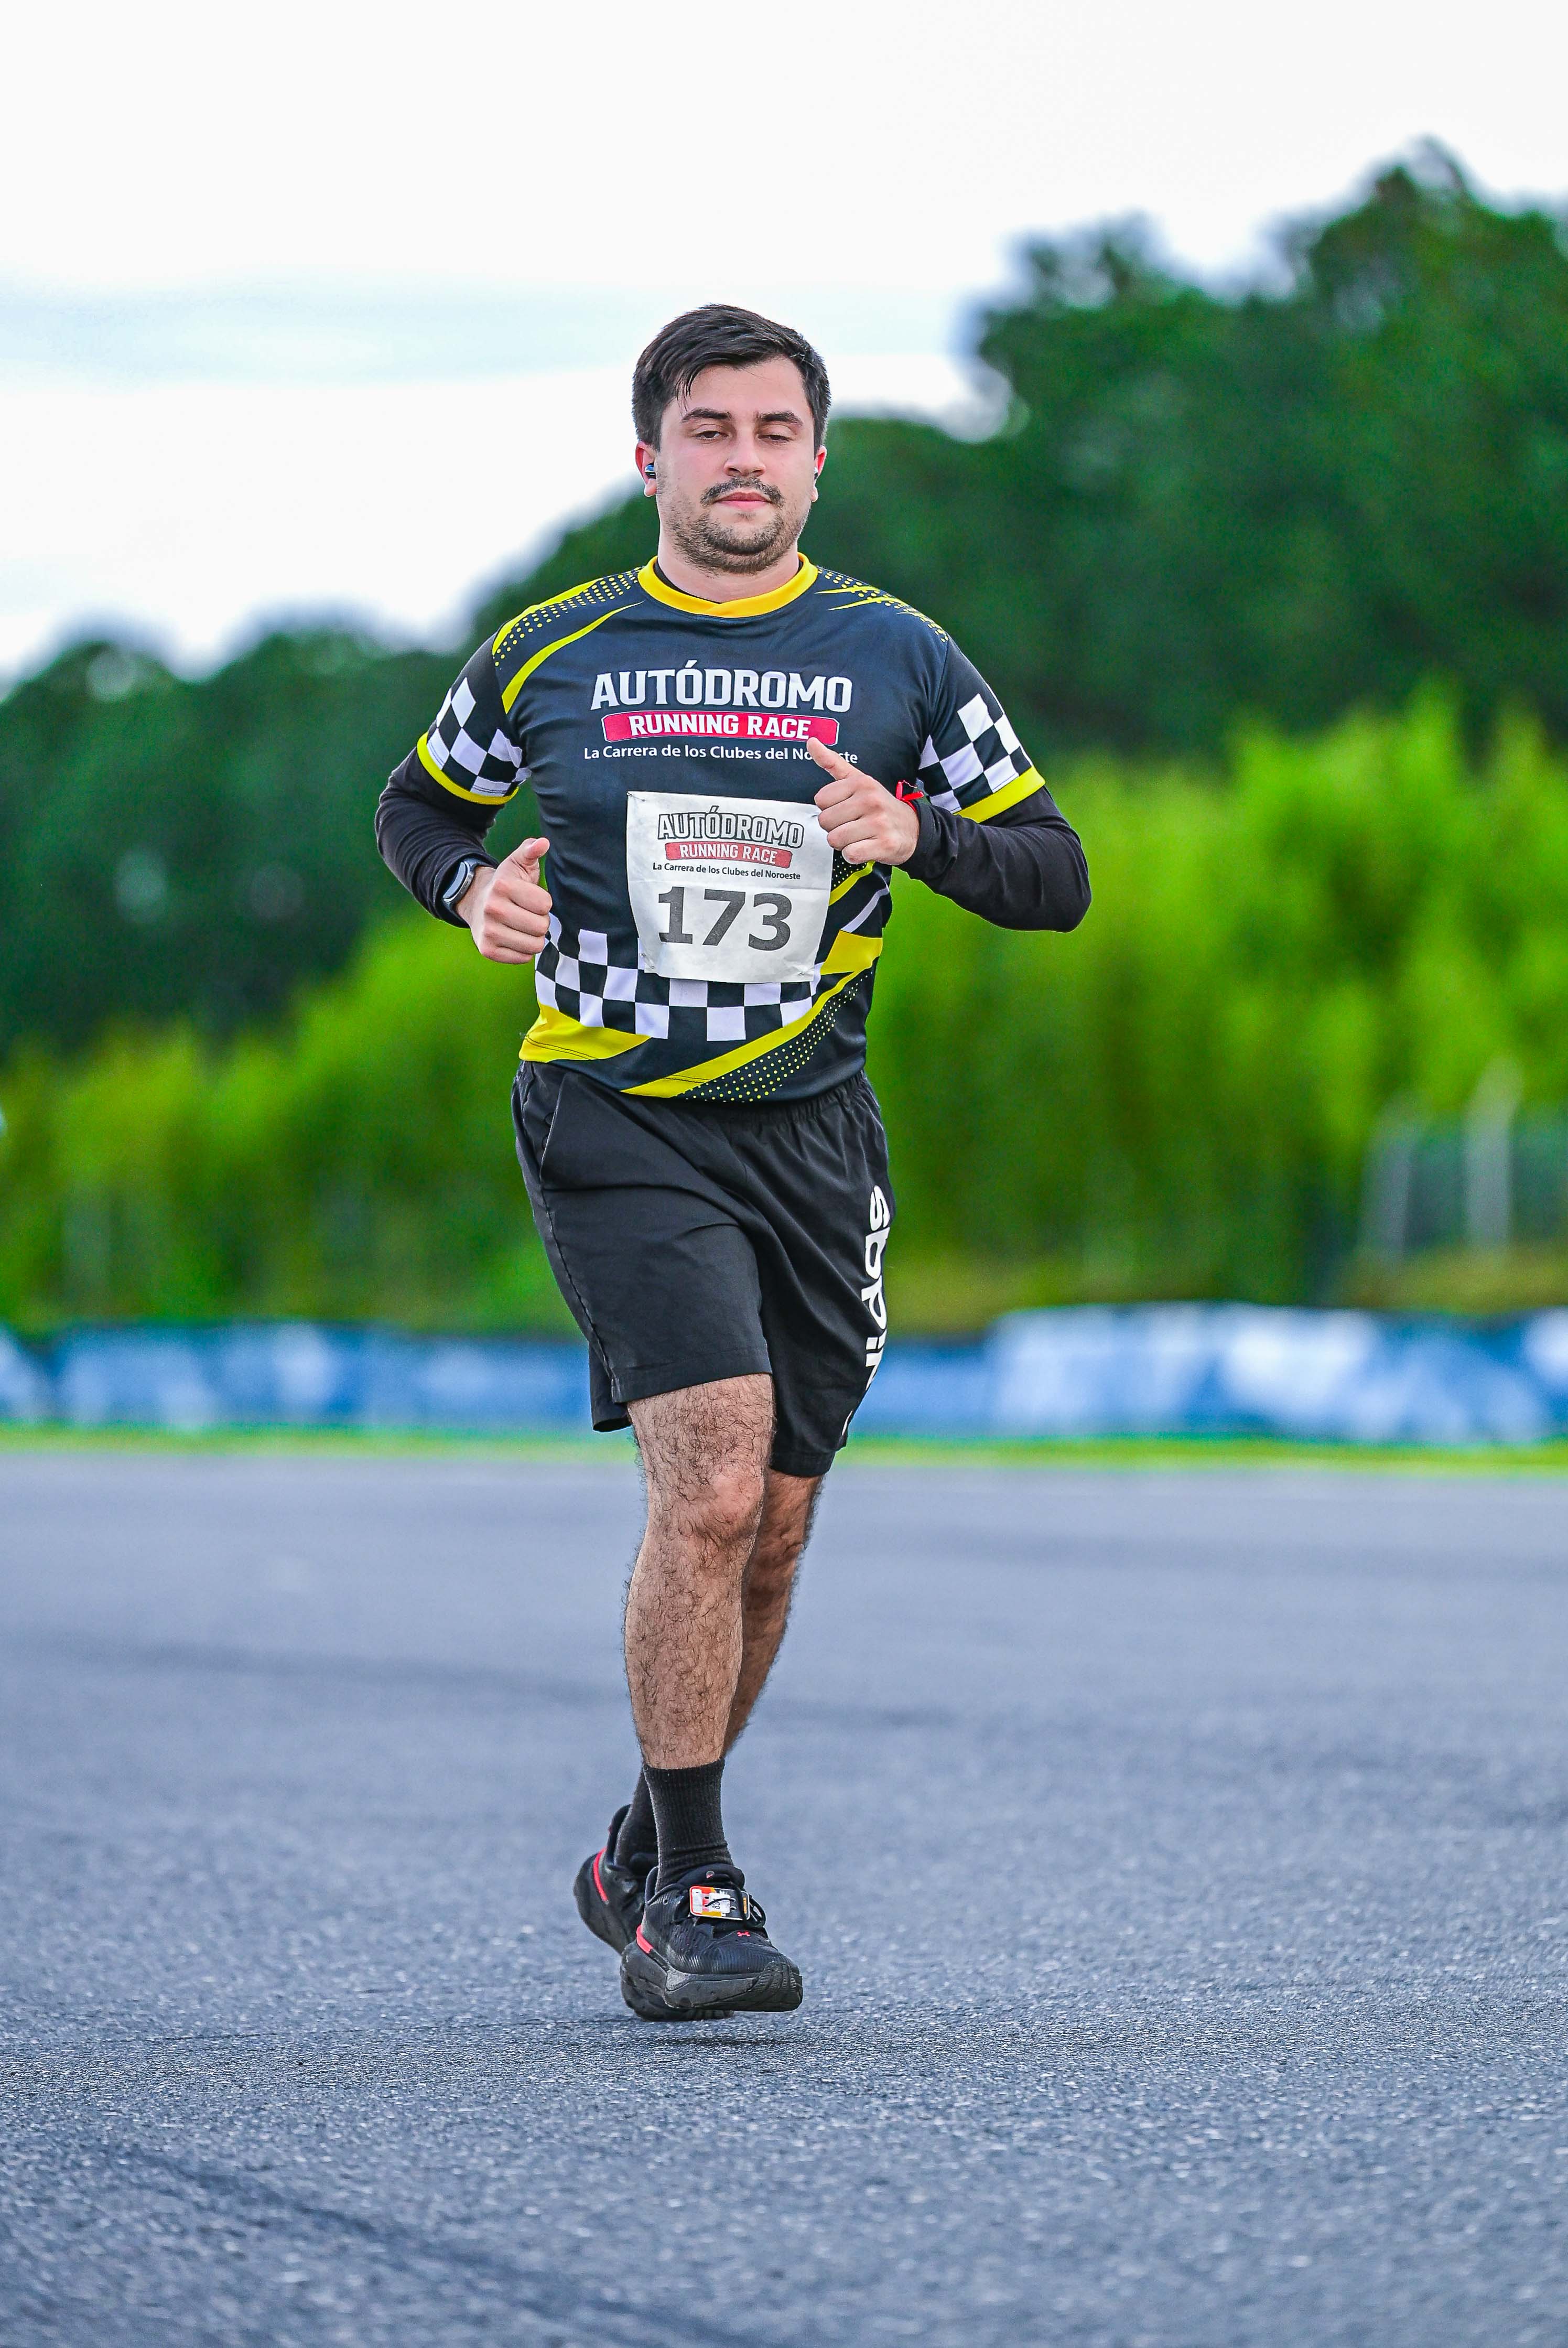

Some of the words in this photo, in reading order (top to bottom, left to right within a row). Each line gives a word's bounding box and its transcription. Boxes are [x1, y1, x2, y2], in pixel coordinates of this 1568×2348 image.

[590, 660, 853, 712] AUTÓDROMO
[628, 714, 739, 736] RUNNING
[747, 717, 812, 740] RACE
[584, 748, 599, 759] La
[603, 746, 657, 758] Carrera
[661, 744, 681, 757] de
[685, 745, 707, 758] los
[710, 746, 761, 759] Clubes
[765, 747, 788, 760] del
[657, 805, 804, 848] AUTÓDROMO
[679, 844, 738, 859] RUNNING
[742, 848, 778, 865] RACE
[653, 862, 662, 870] La
[664, 863, 694, 872] Carrera
[696, 865, 707, 873] de
[708, 865, 720, 874] los
[722, 867, 749, 876] Clubes
[751, 869, 763, 877] del
[765, 870, 801, 880] Noroeste
[658, 886, 792, 951] 173
